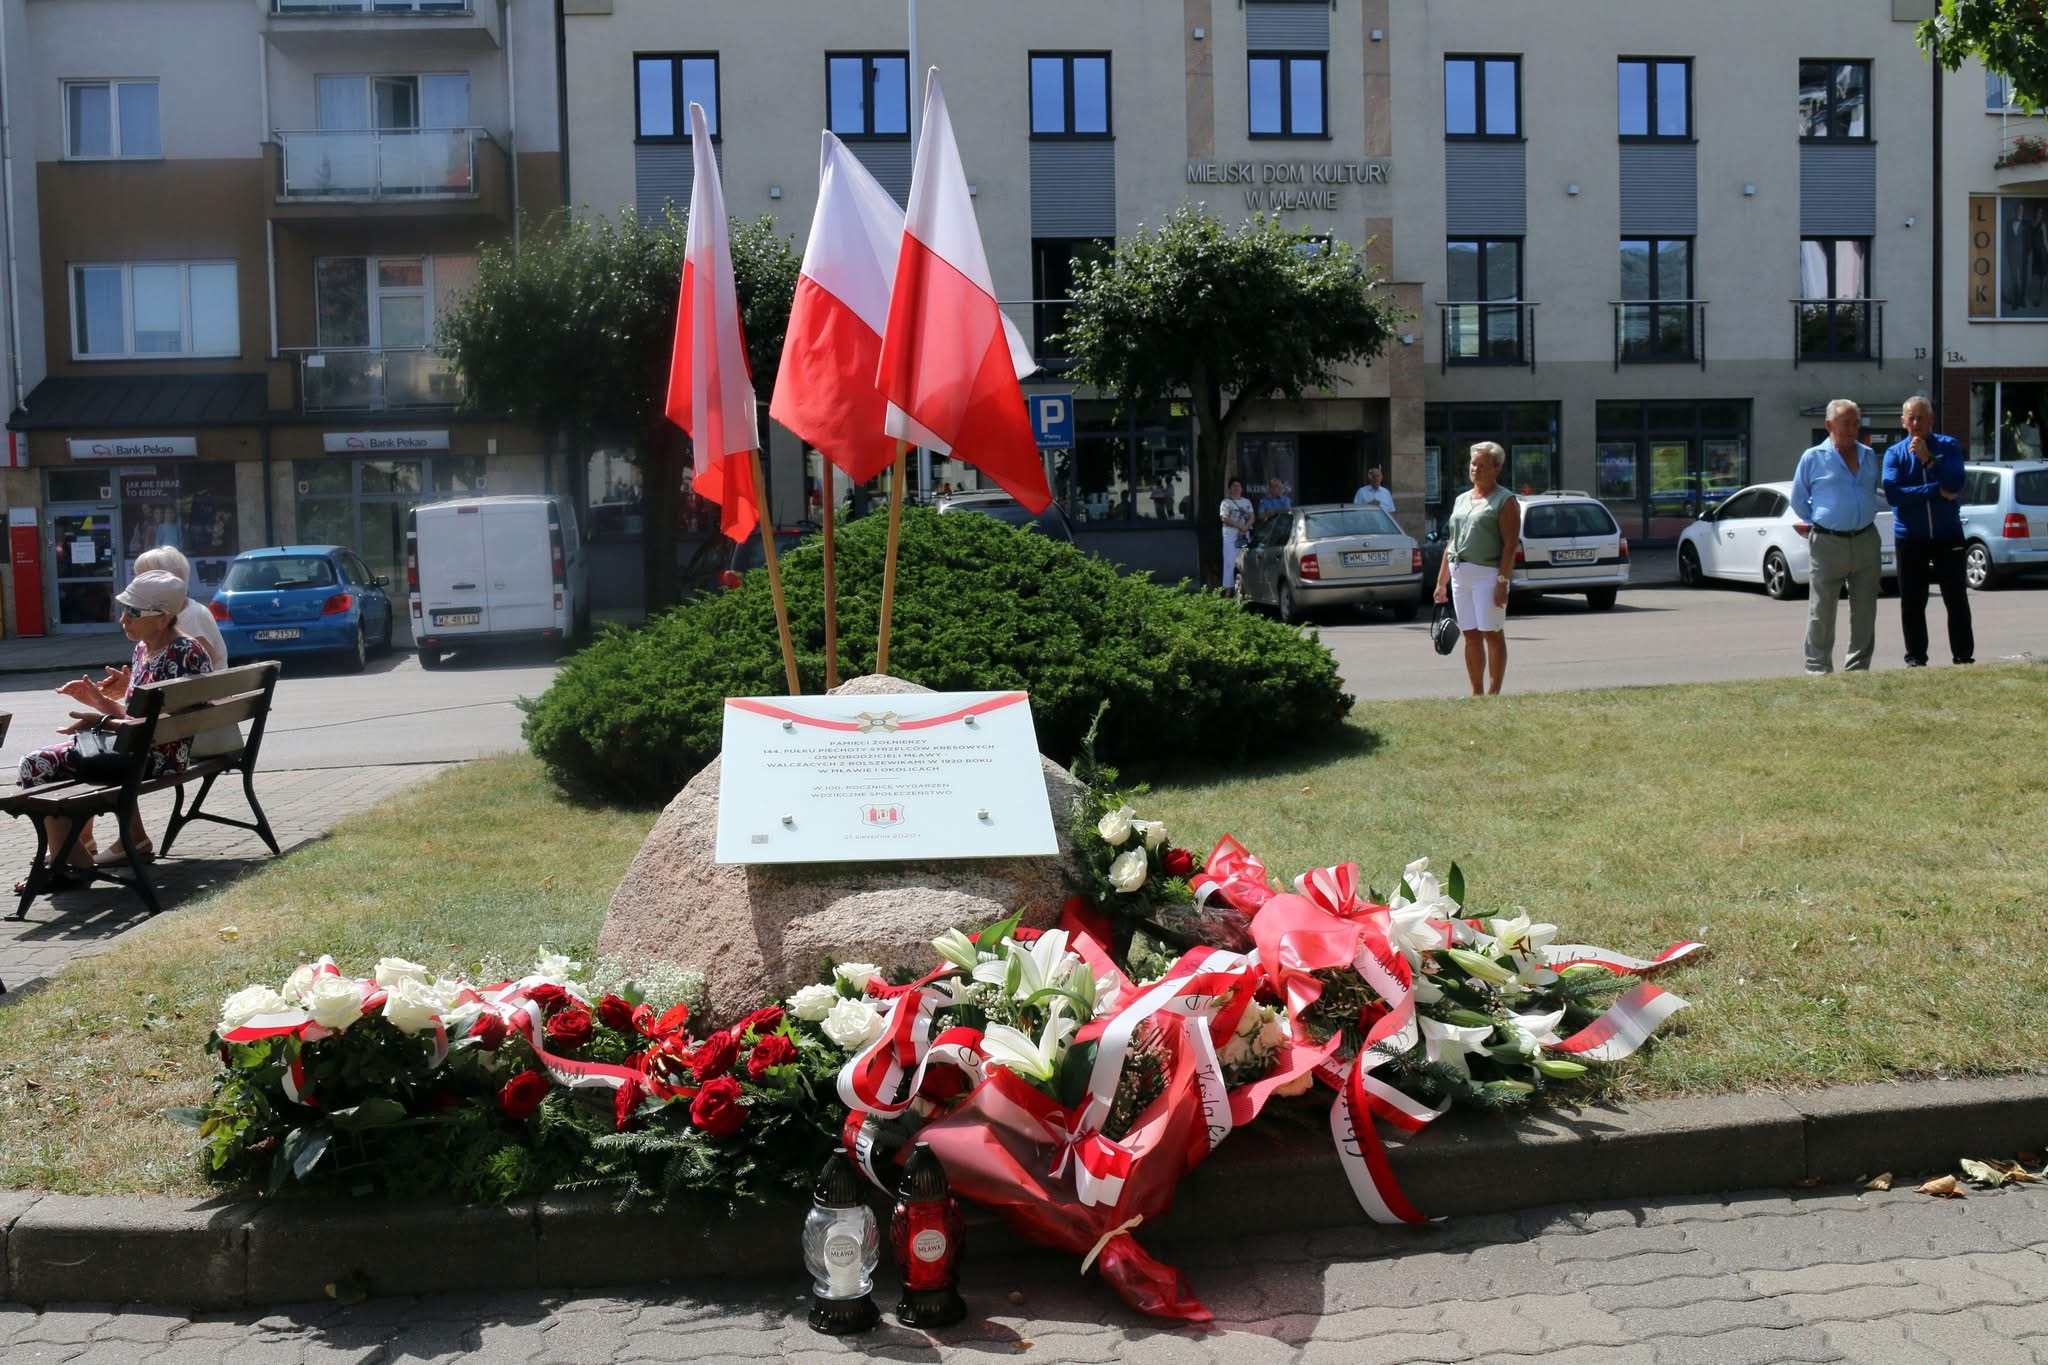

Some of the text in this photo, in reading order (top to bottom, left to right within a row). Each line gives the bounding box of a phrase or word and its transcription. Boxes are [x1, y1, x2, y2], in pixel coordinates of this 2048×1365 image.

[1187, 163, 1393, 185] MIEJSKI DOM KULTURY
[1245, 191, 1338, 212] W MŁAWIE
[1973, 204, 1991, 303] LOOK
[1914, 347, 1927, 360] 13
[1040, 399, 1065, 433] P
[116, 444, 174, 455] Bank Pekao
[369, 437, 427, 449] Bank Pekao
